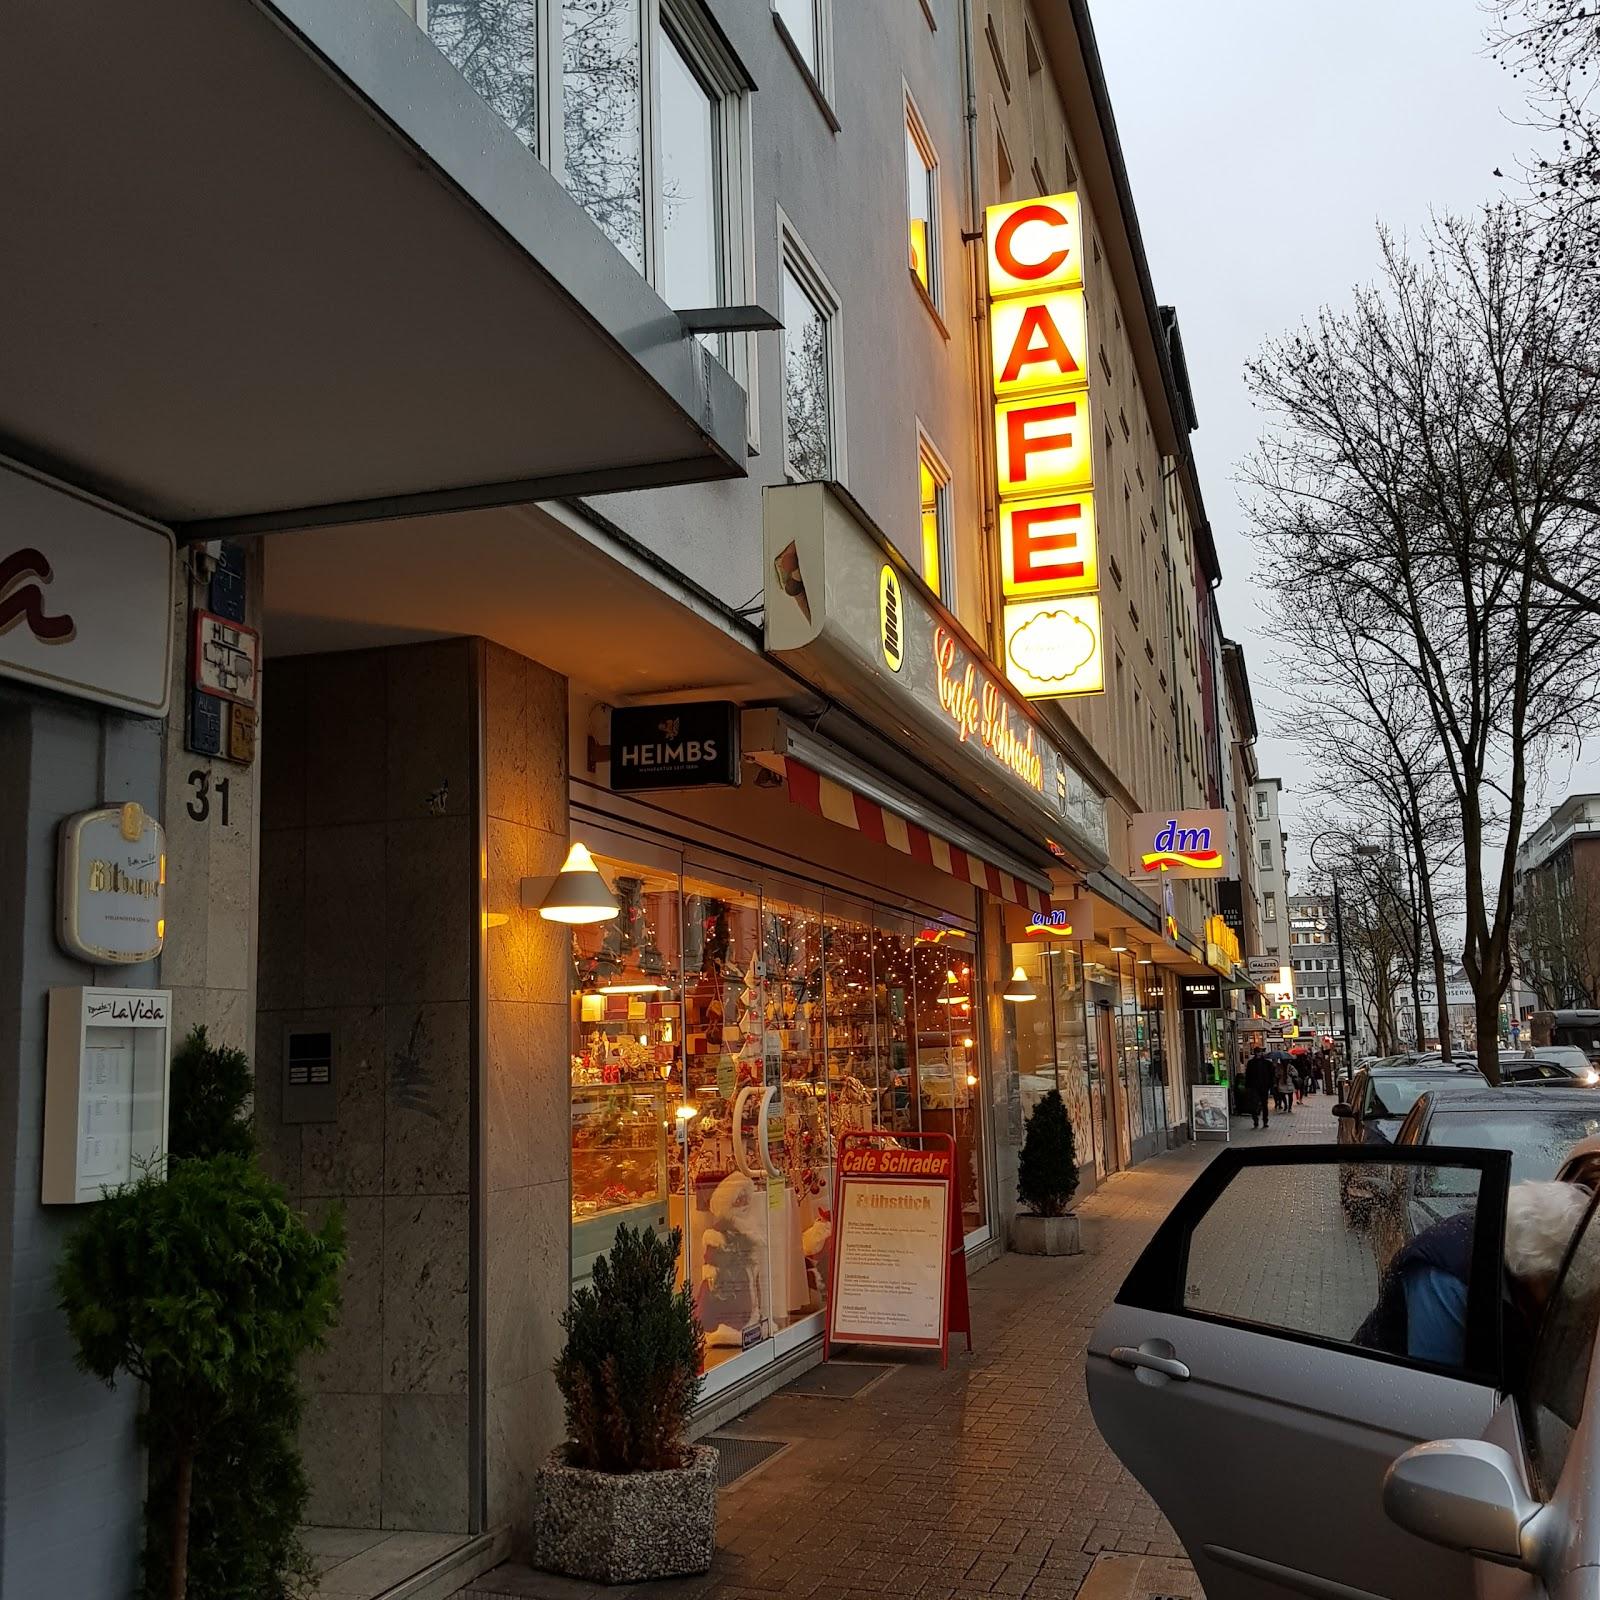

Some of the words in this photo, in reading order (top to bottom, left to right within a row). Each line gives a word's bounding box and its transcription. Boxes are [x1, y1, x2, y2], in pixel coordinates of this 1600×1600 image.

[994, 205, 1085, 583] CAFE
[622, 740, 718, 767] HEIMBS
[186, 769, 229, 827] 31
[1154, 819, 1211, 852] dm
[88, 859, 159, 898] Bitburger
[843, 1150, 876, 1172] Cafe
[880, 1152, 949, 1174] Schrader
